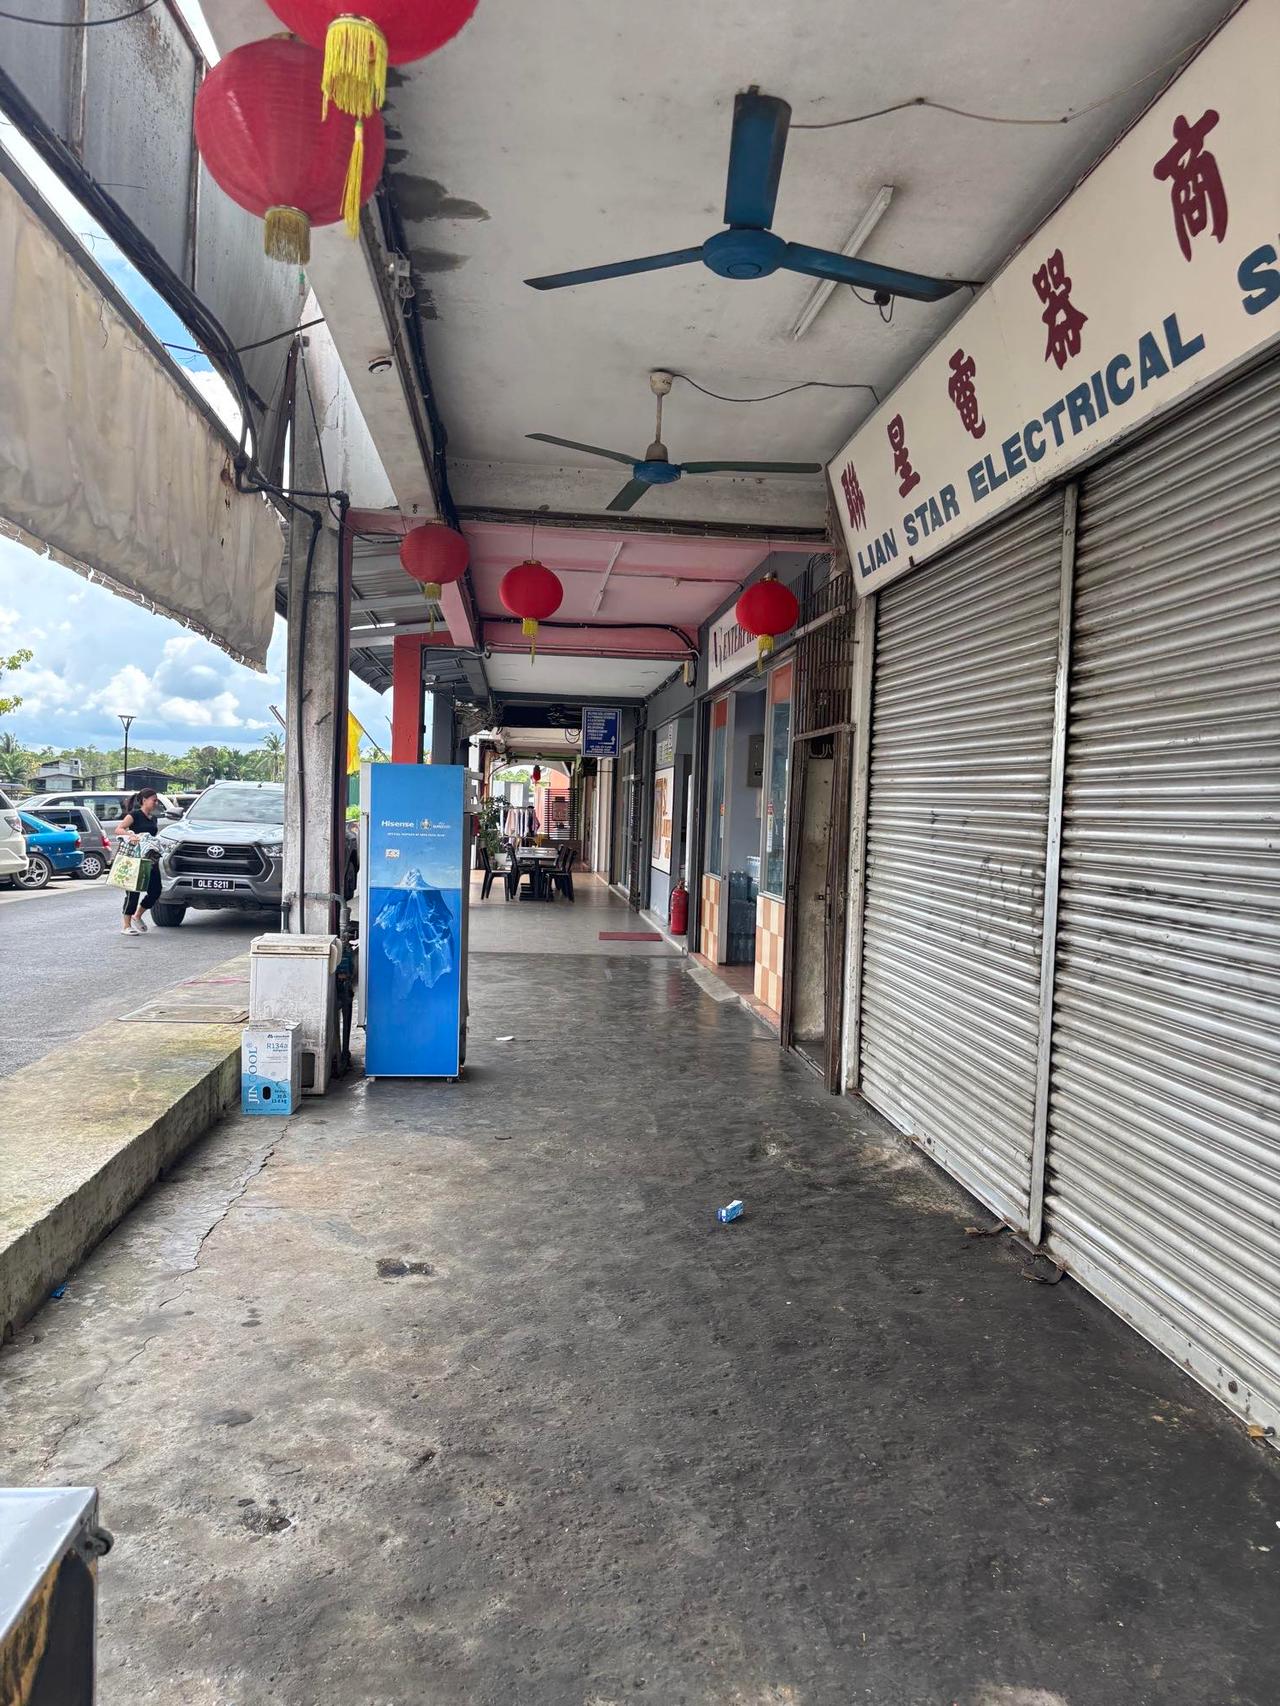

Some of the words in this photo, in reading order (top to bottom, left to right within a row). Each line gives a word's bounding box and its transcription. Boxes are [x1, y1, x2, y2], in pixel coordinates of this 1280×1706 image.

[858, 528, 898, 578] LIAN
[903, 484, 960, 546] STAR
[967, 313, 1205, 502] ELECTRICAL
[1237, 240, 1280, 315] S
[381, 820, 415, 828] Hisense
[213, 880, 229, 889] 5211
